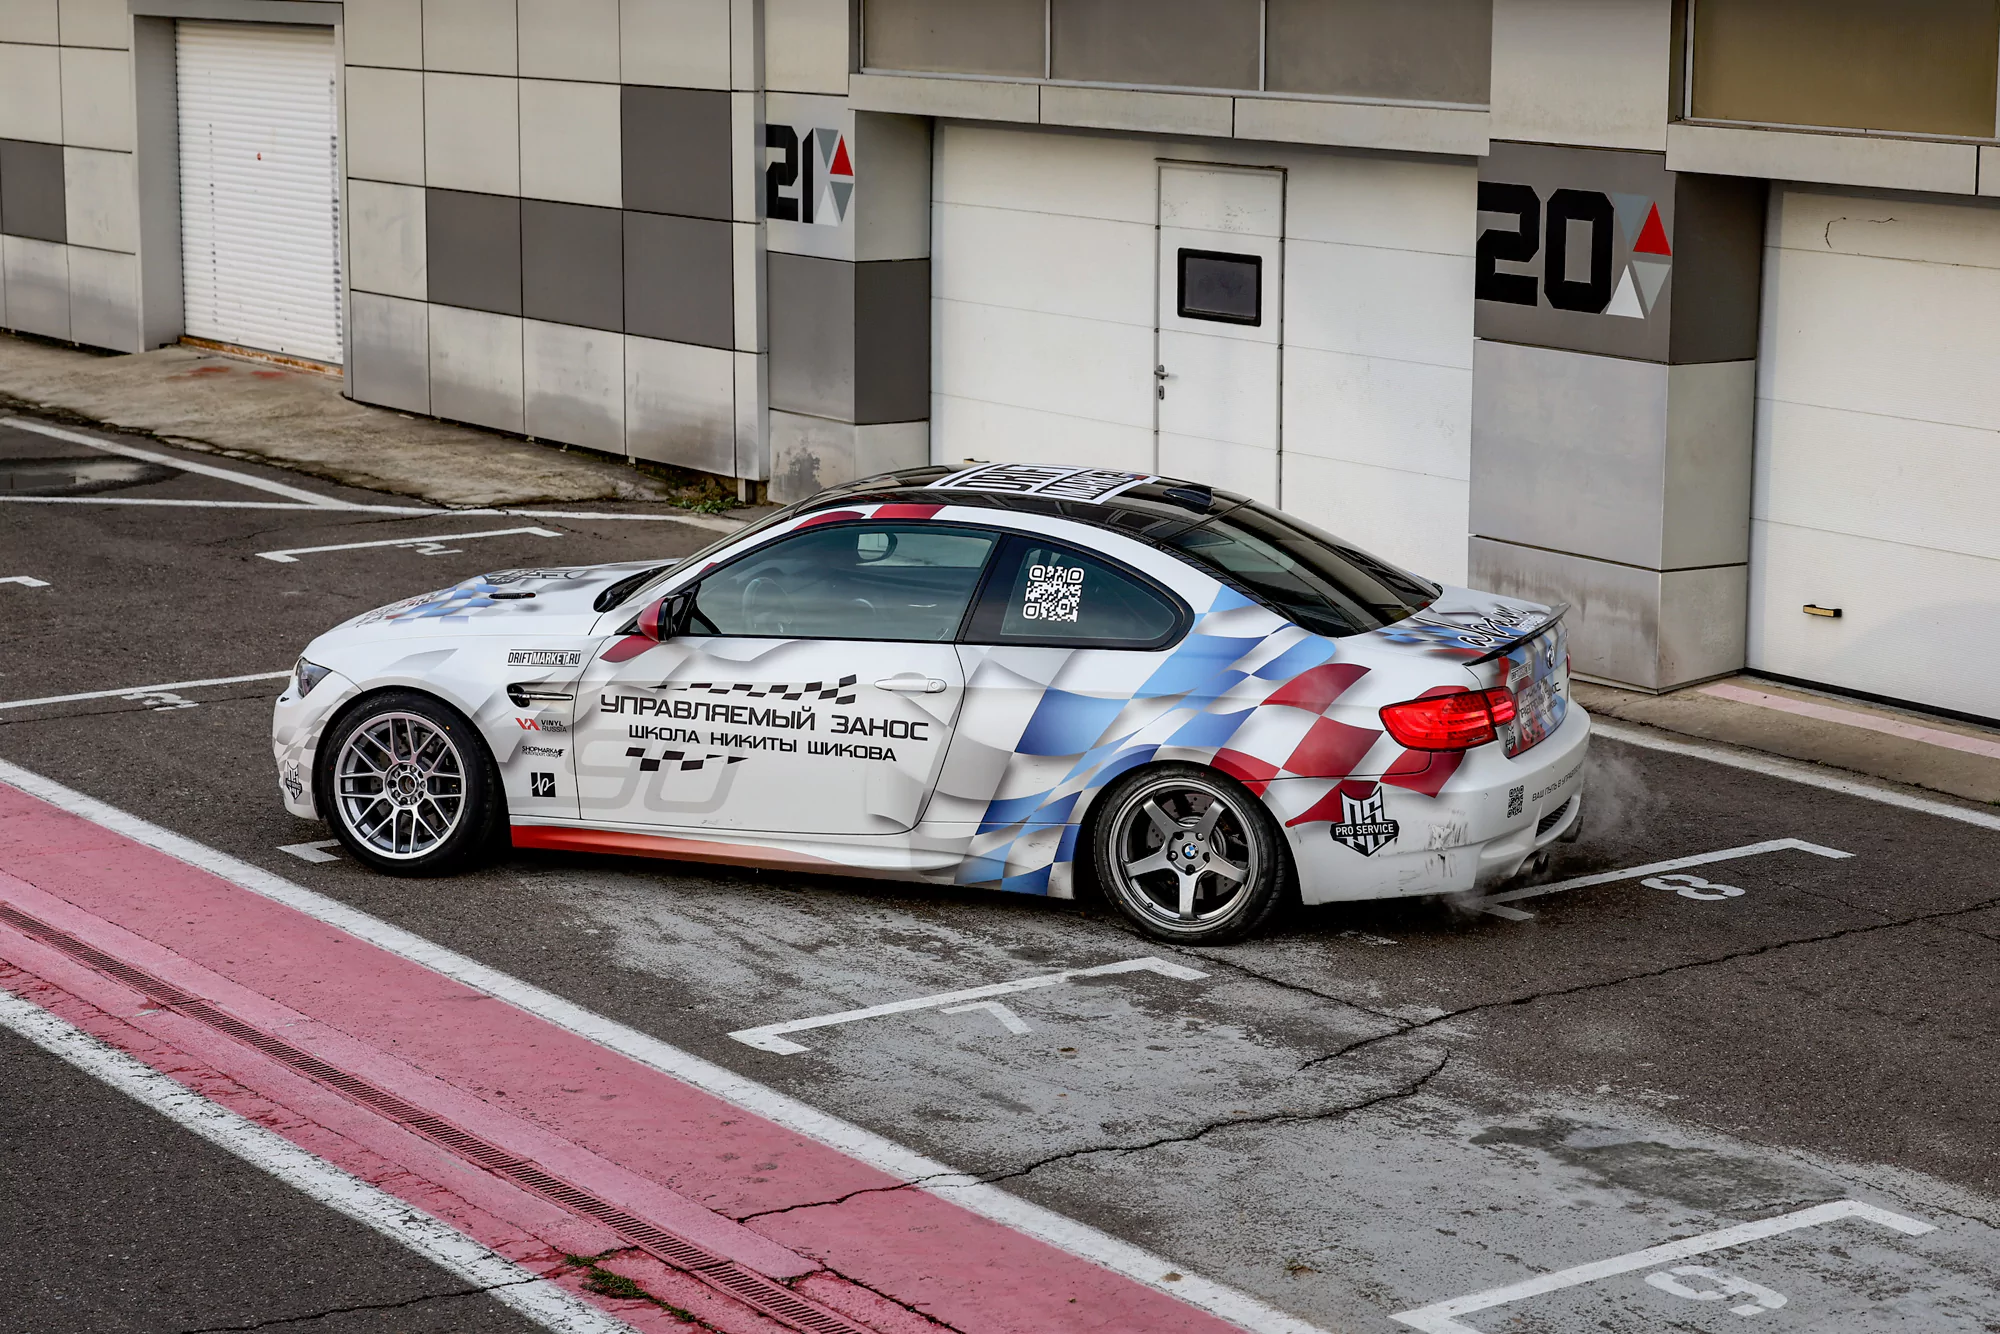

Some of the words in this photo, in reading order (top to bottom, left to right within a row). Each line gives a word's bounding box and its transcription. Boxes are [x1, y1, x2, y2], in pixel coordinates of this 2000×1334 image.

[765, 123, 814, 224] 21
[1475, 180, 1615, 315] 20
[954, 463, 1077, 492] DRIFT
[508, 651, 580, 665] DRIFTMARKET.RU
[541, 719, 563, 727] VINYL
[542, 725, 567, 733] RUSSIA
[600, 694, 816, 731] УПРАВЛЯЕМЫЙ
[831, 714, 929, 742] ЗАНОС
[521, 745, 558, 754] SHOPMARKA
[628, 725, 701, 744] ШКОЛА
[710, 732, 797, 752] НИКИТЫ
[807, 740, 897, 762] ШИКОВА
[1335, 826, 1354, 836] PRO
[1356, 823, 1394, 835] SERVICE
[1640, 874, 1746, 901] 8
